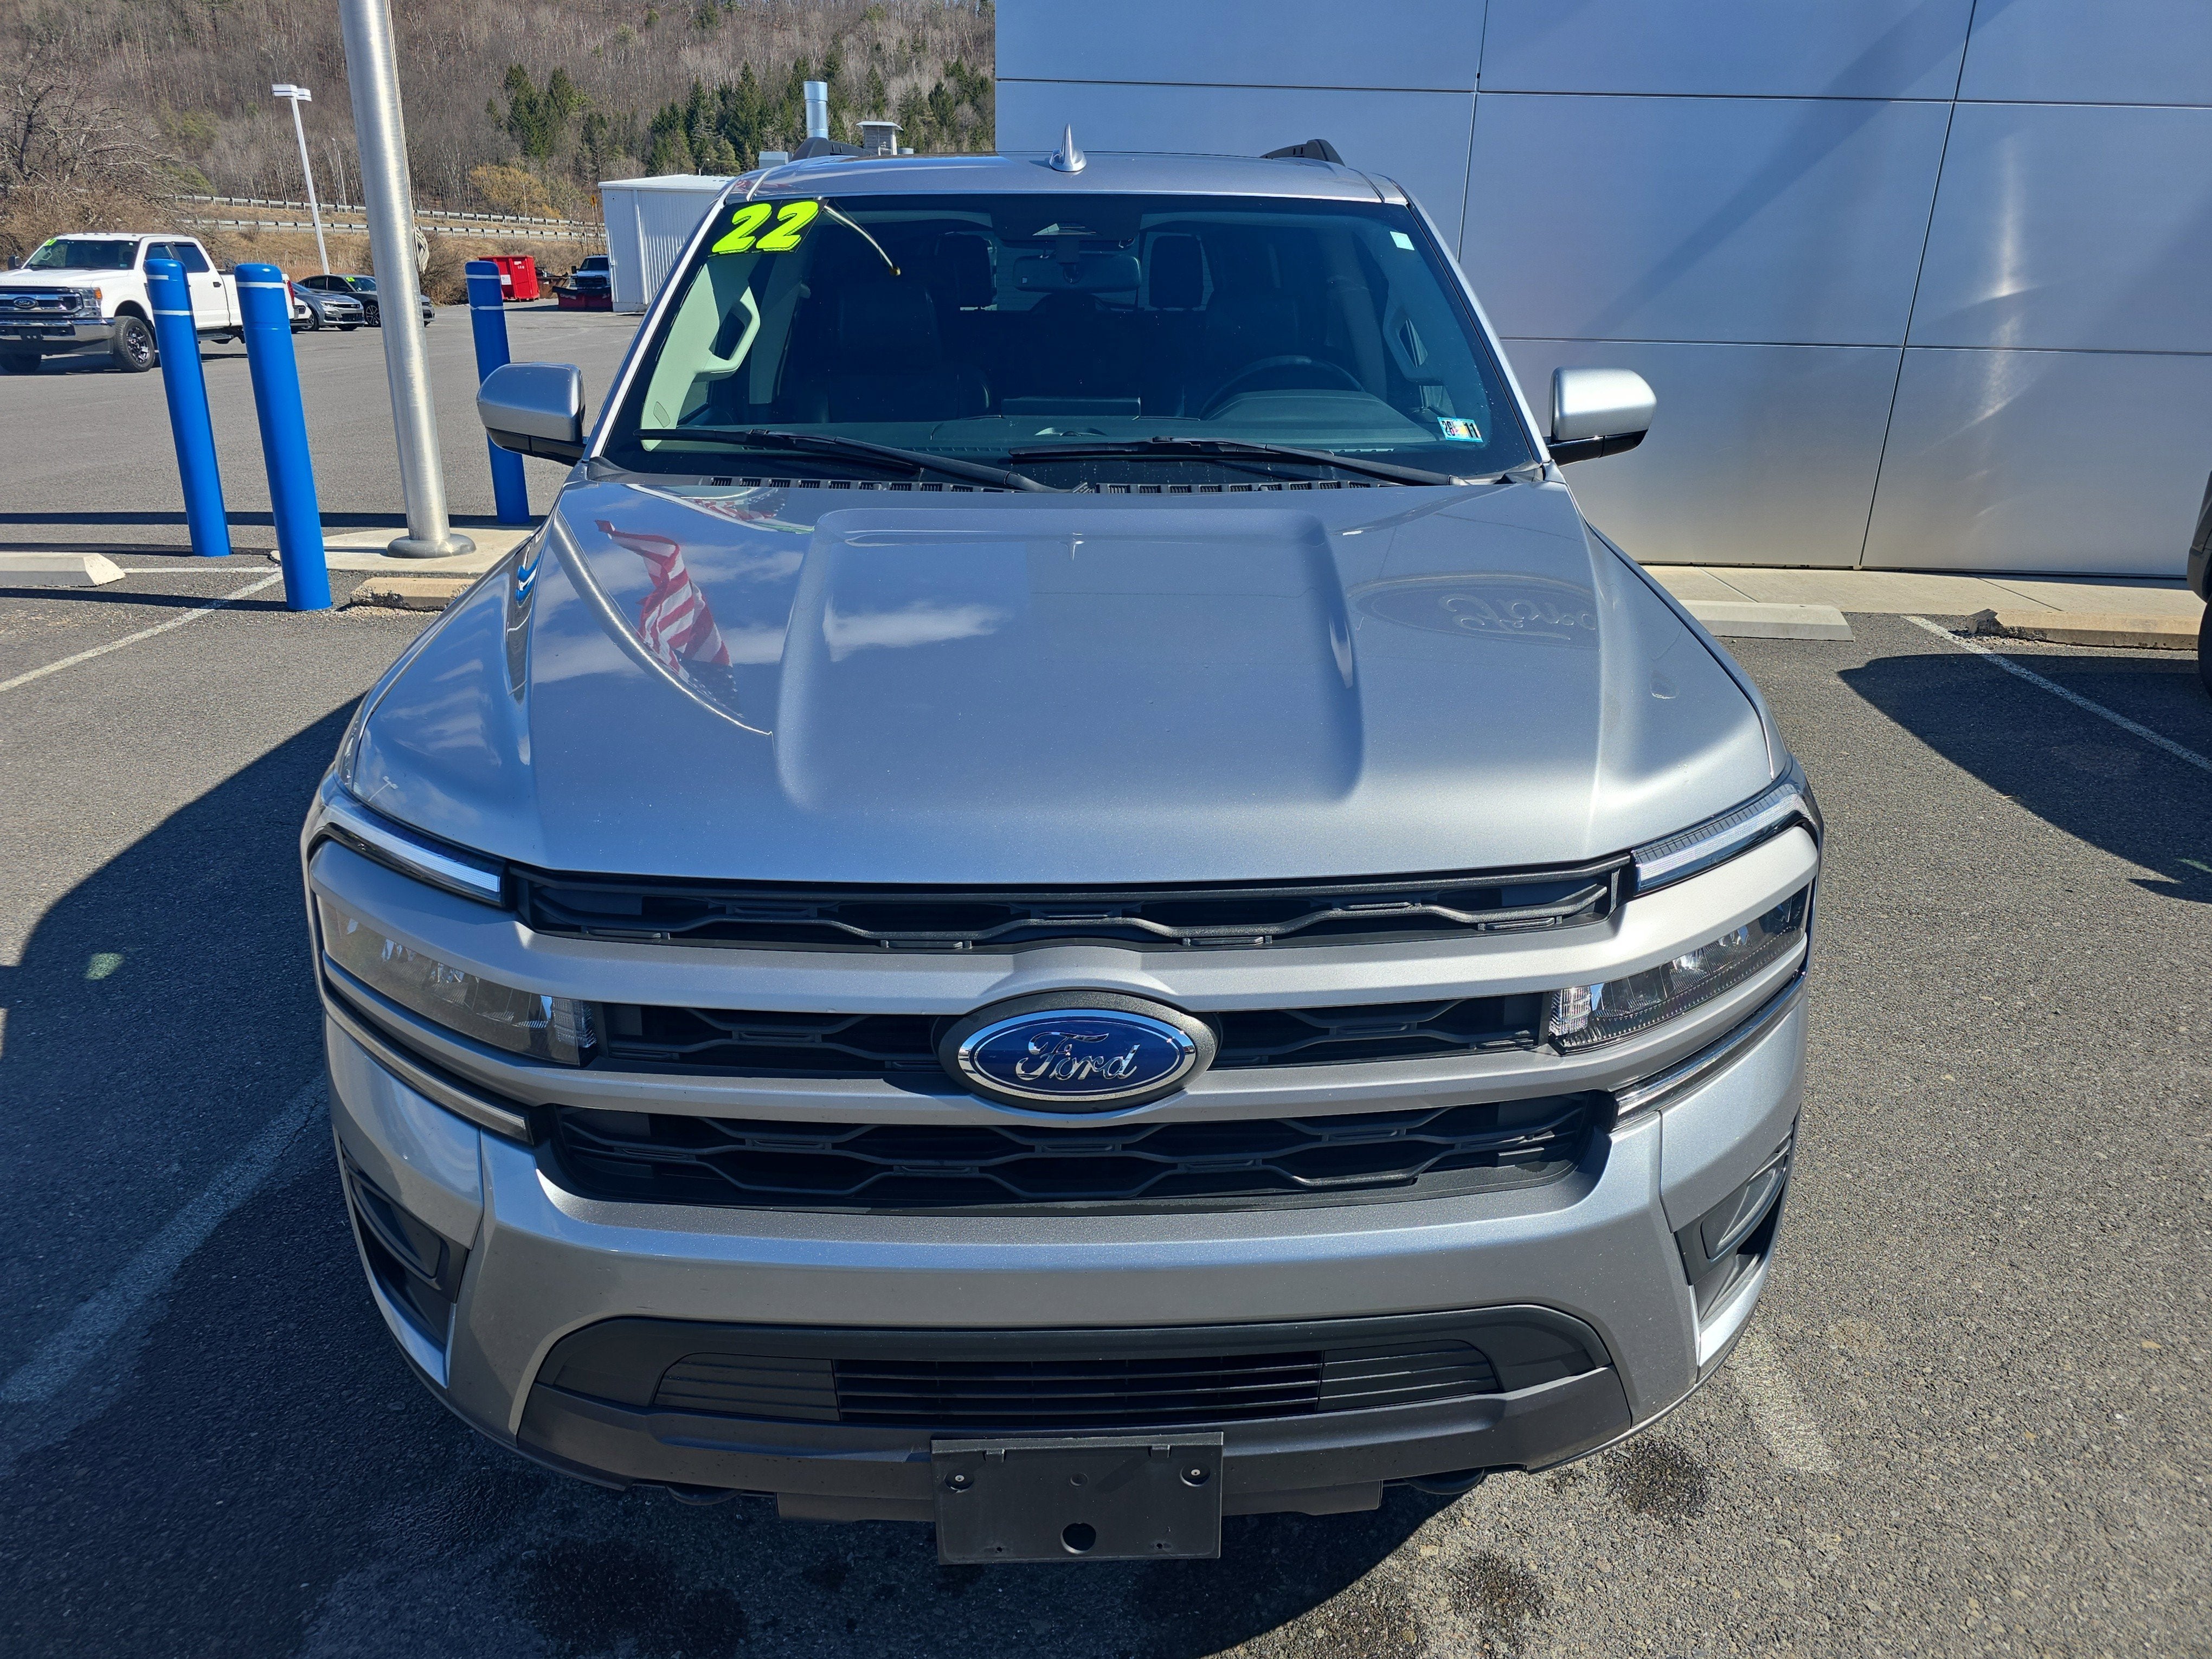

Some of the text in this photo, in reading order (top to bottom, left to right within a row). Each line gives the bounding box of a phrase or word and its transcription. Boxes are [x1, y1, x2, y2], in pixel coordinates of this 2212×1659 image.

[712, 201, 820, 254] 22
[1464, 422, 1478, 438] 11
[1014, 1031, 1141, 1081] Ford
